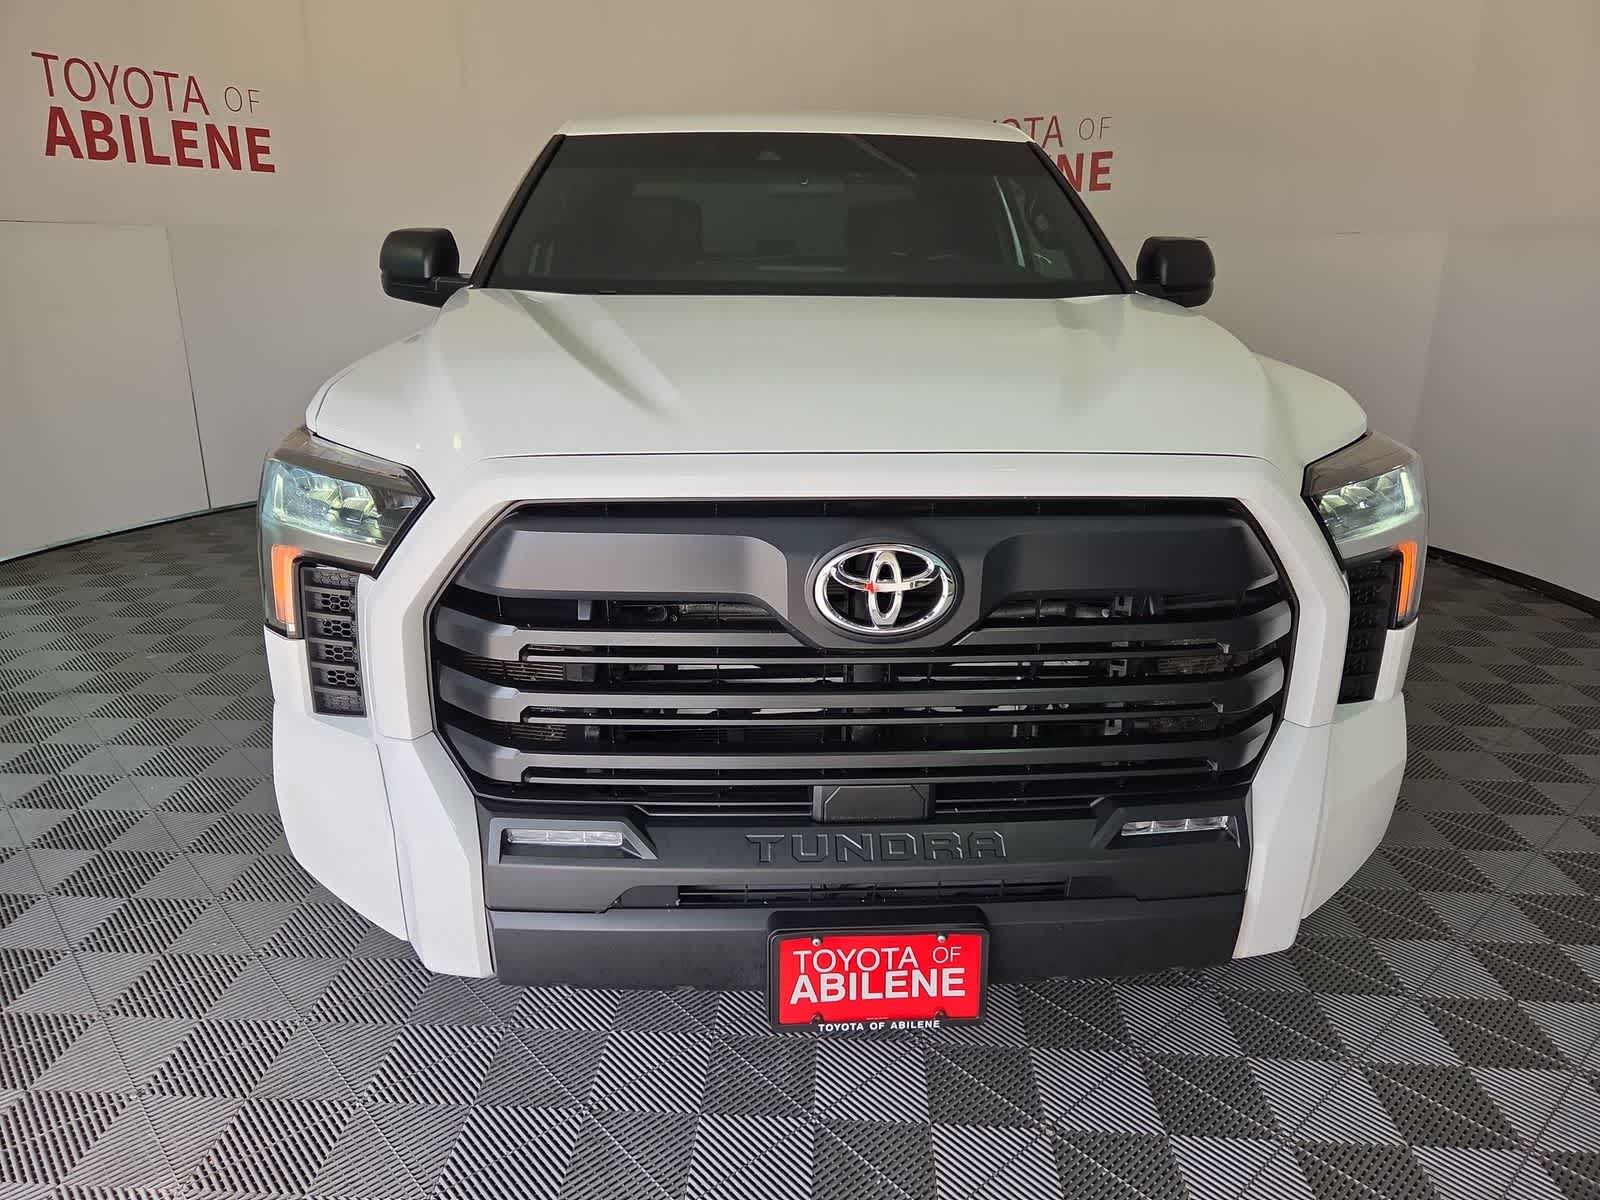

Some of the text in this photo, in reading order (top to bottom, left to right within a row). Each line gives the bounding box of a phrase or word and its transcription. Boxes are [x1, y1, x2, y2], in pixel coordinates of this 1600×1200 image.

[31, 51, 261, 115] TOYOTA OF
[45, 105, 276, 173] ABILENE
[1079, 116, 1112, 141] OF
[745, 831, 1008, 863] TUNDRA
[793, 946, 962, 974] TOYOTA OF
[790, 967, 965, 1005] ABILENE
[818, 1020, 940, 1032] TOYOTA OF ABILENE
